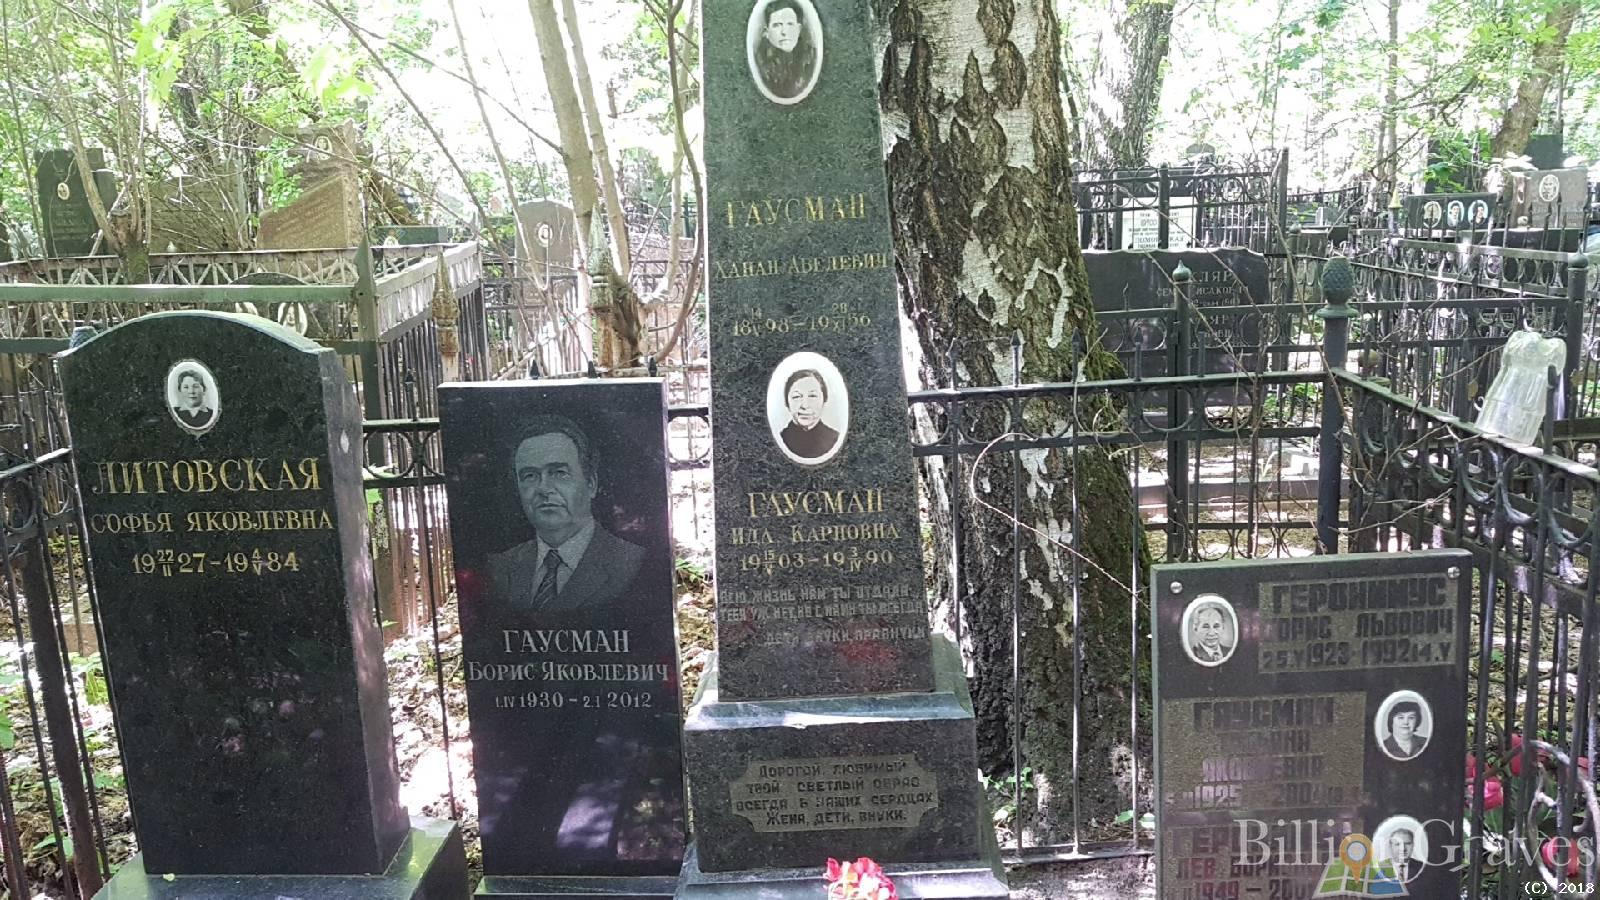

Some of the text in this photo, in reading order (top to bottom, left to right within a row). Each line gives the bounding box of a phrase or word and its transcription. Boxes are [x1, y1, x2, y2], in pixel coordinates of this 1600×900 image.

[726, 193, 866, 229] ГАУСМАН
[716, 260, 779, 279] ХАНАН
[92, 457, 323, 495] ЛИТОВСКАЯ
[748, 488, 886, 518] ГАУСМАН
[90, 508, 335, 534] СОФЬЯ ЯКОВЛЕВНА
[731, 522, 901, 545] ИДА КАРПОВНА
[1355, 609, 1454, 638] ЛЬВОВИЧ
[502, 629, 631, 653] ГАУСМАН
[468, 661, 669, 681] БОРИС ЯКОВЛЕВИЧ
[520, 692, 564, 708] 1930
[608, 692, 651, 708] 2012
[745, 780, 780, 794] ТВОЙ
[797, 777, 864, 793] СВЕТЛЫЙ
[736, 798, 788, 812] ВСЕГДА
[815, 795, 861, 809] НАШИХ
[871, 792, 933, 806] СЕРДЦАХ
